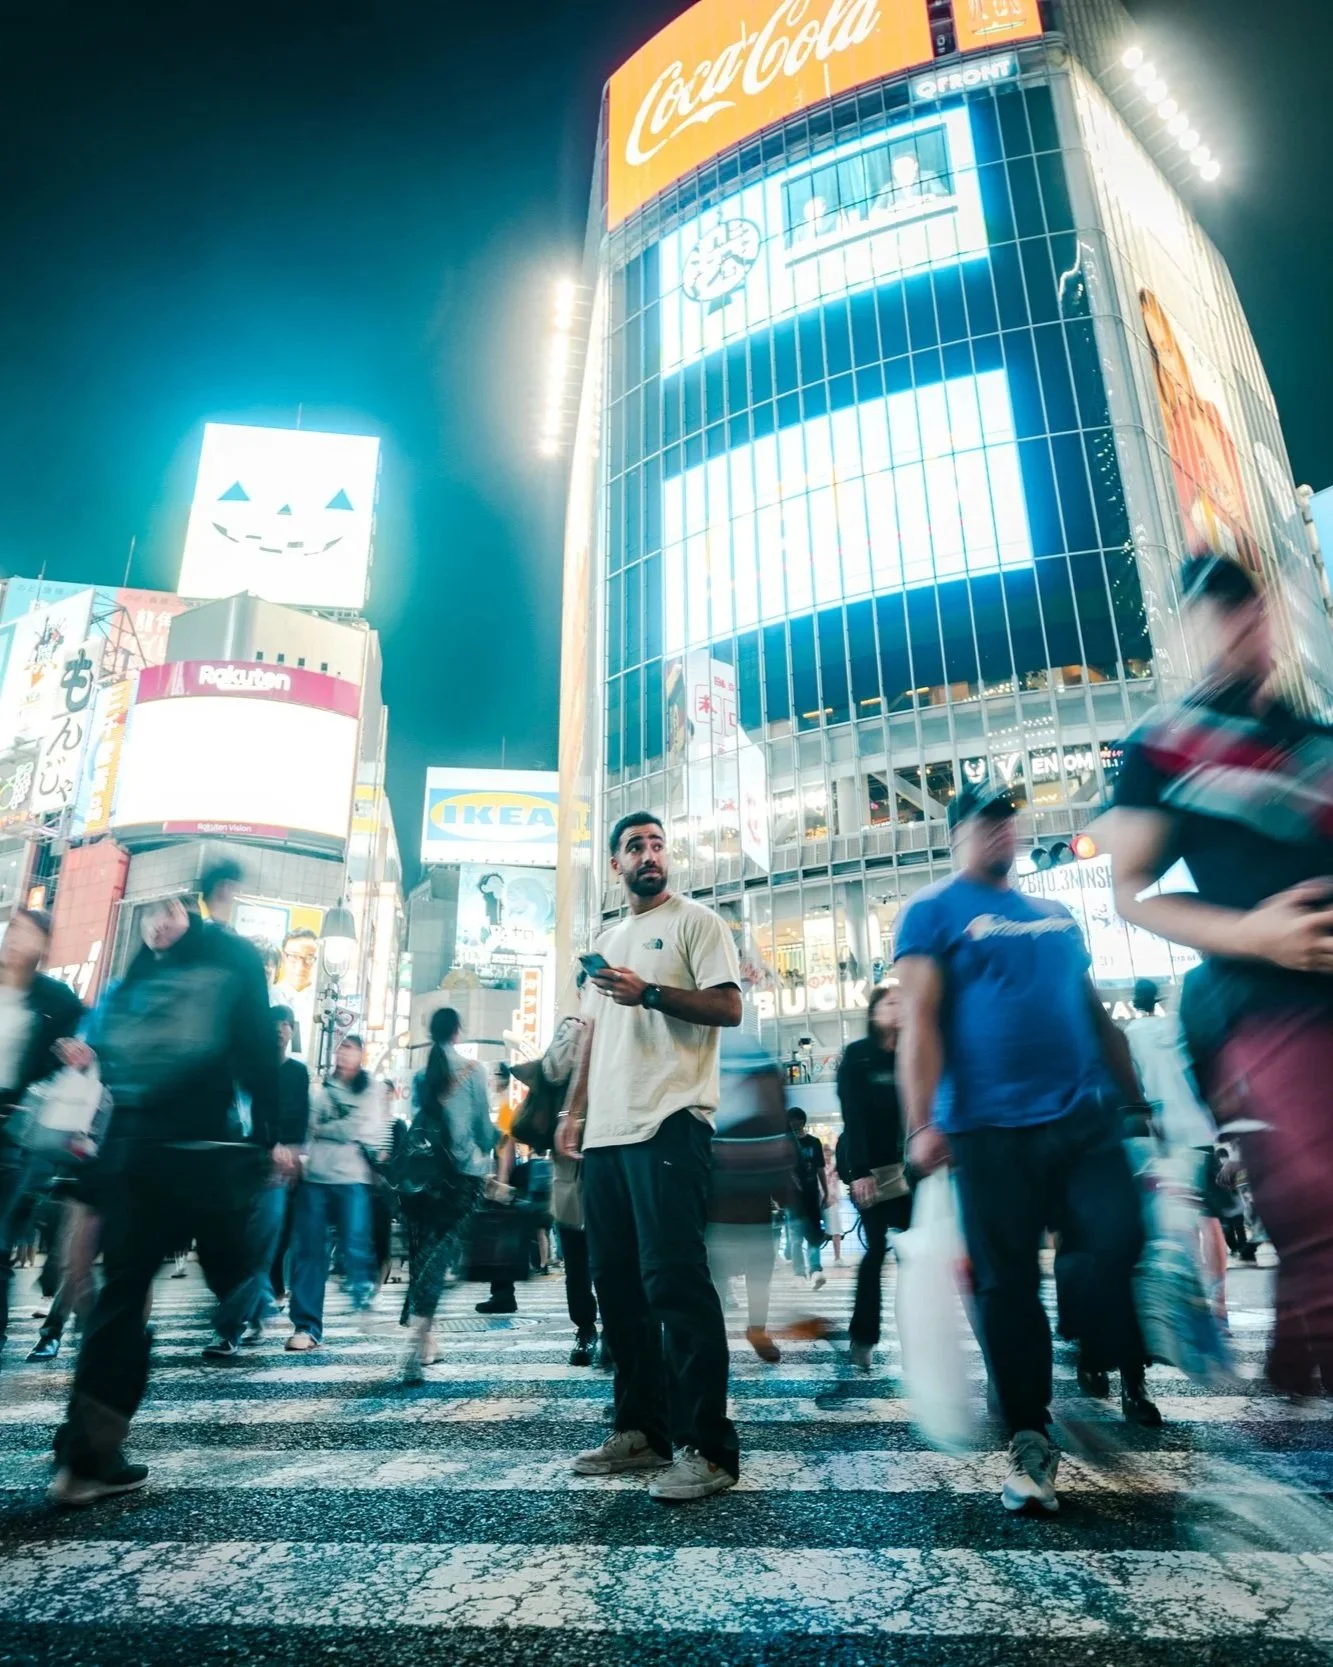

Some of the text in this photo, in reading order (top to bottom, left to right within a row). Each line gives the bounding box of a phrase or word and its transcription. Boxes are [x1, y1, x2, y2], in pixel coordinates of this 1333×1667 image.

[625, 0, 882, 166] Coca-Cola
[199, 664, 291, 691] Rakuten
[443, 804, 556, 826] IKEA
[197, 823, 252, 832] Rakuten Vision
